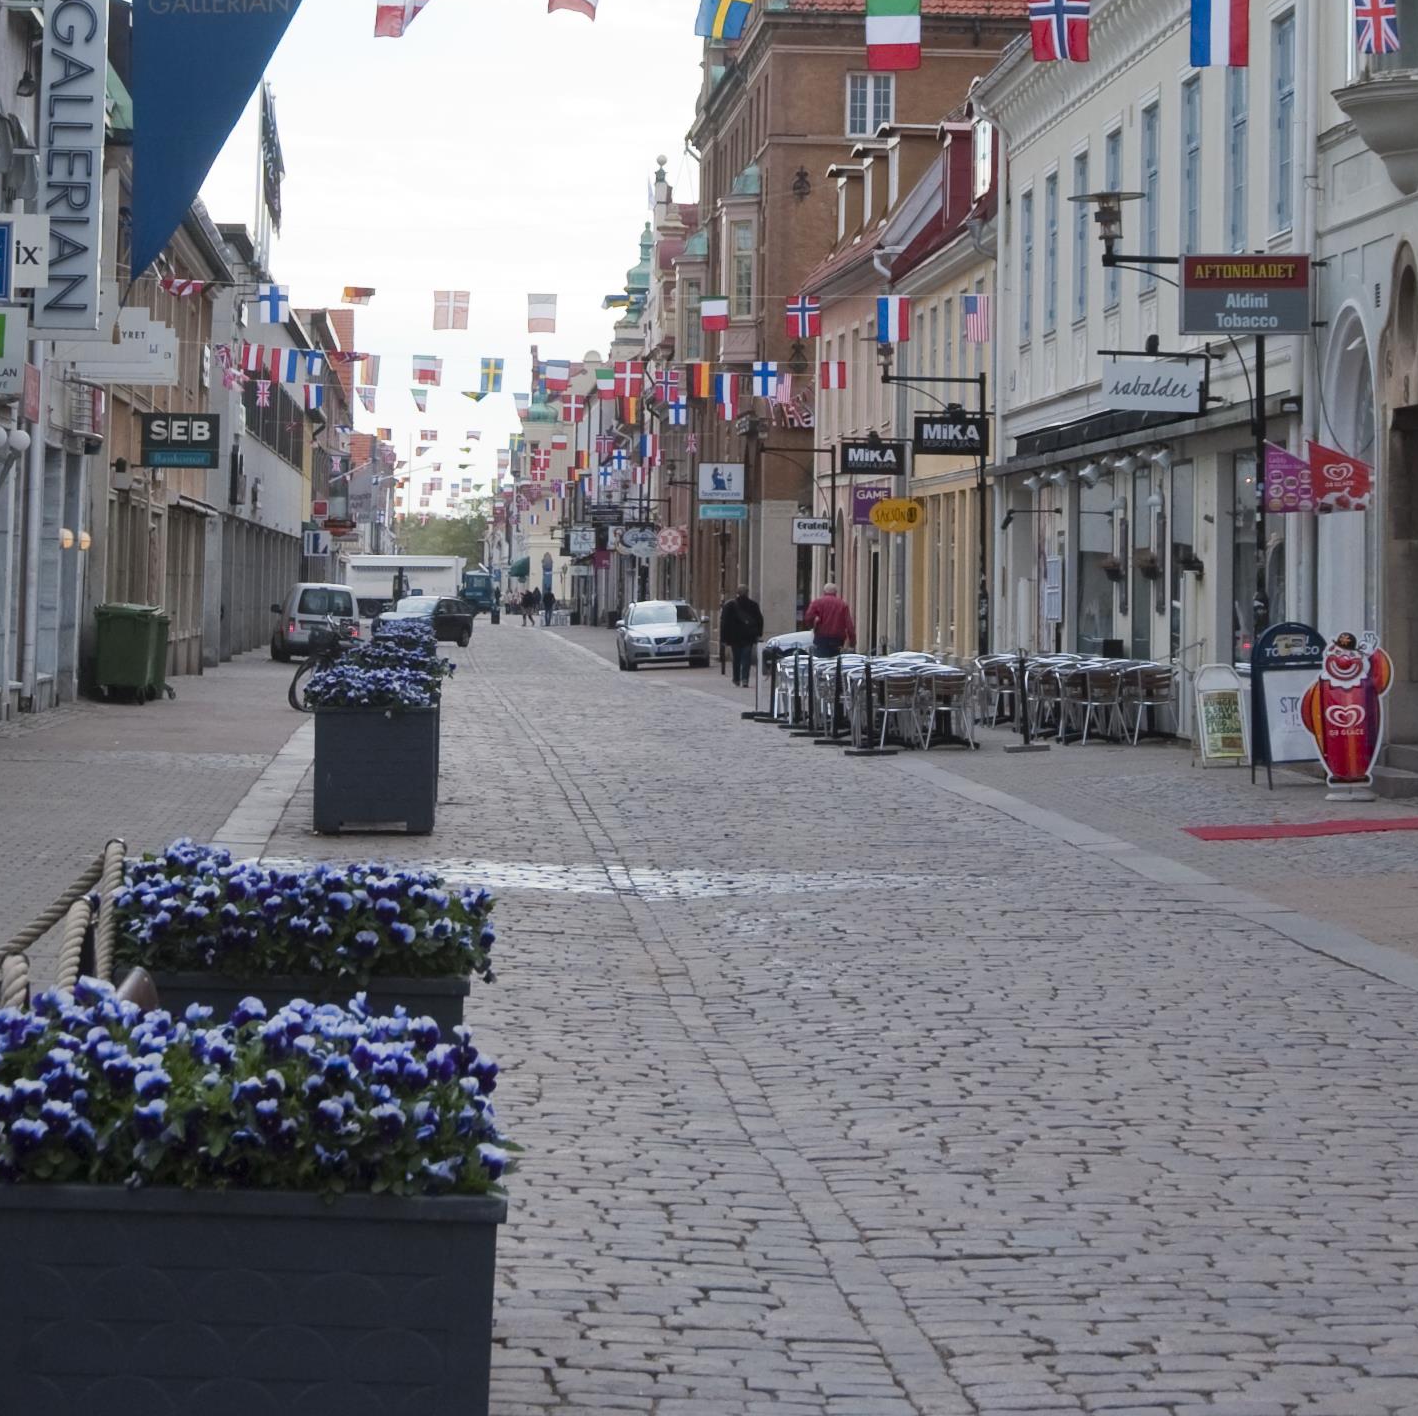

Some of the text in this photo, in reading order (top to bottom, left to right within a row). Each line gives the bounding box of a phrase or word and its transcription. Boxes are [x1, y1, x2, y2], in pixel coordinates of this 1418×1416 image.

[1194, 263, 1296, 280] AFTONBLADET
[1225, 292, 1269, 309] Aldini
[1215, 312, 1279, 328] Tobacco
[150, 419, 211, 442] SEB
[856, 489, 888, 500] GAME
